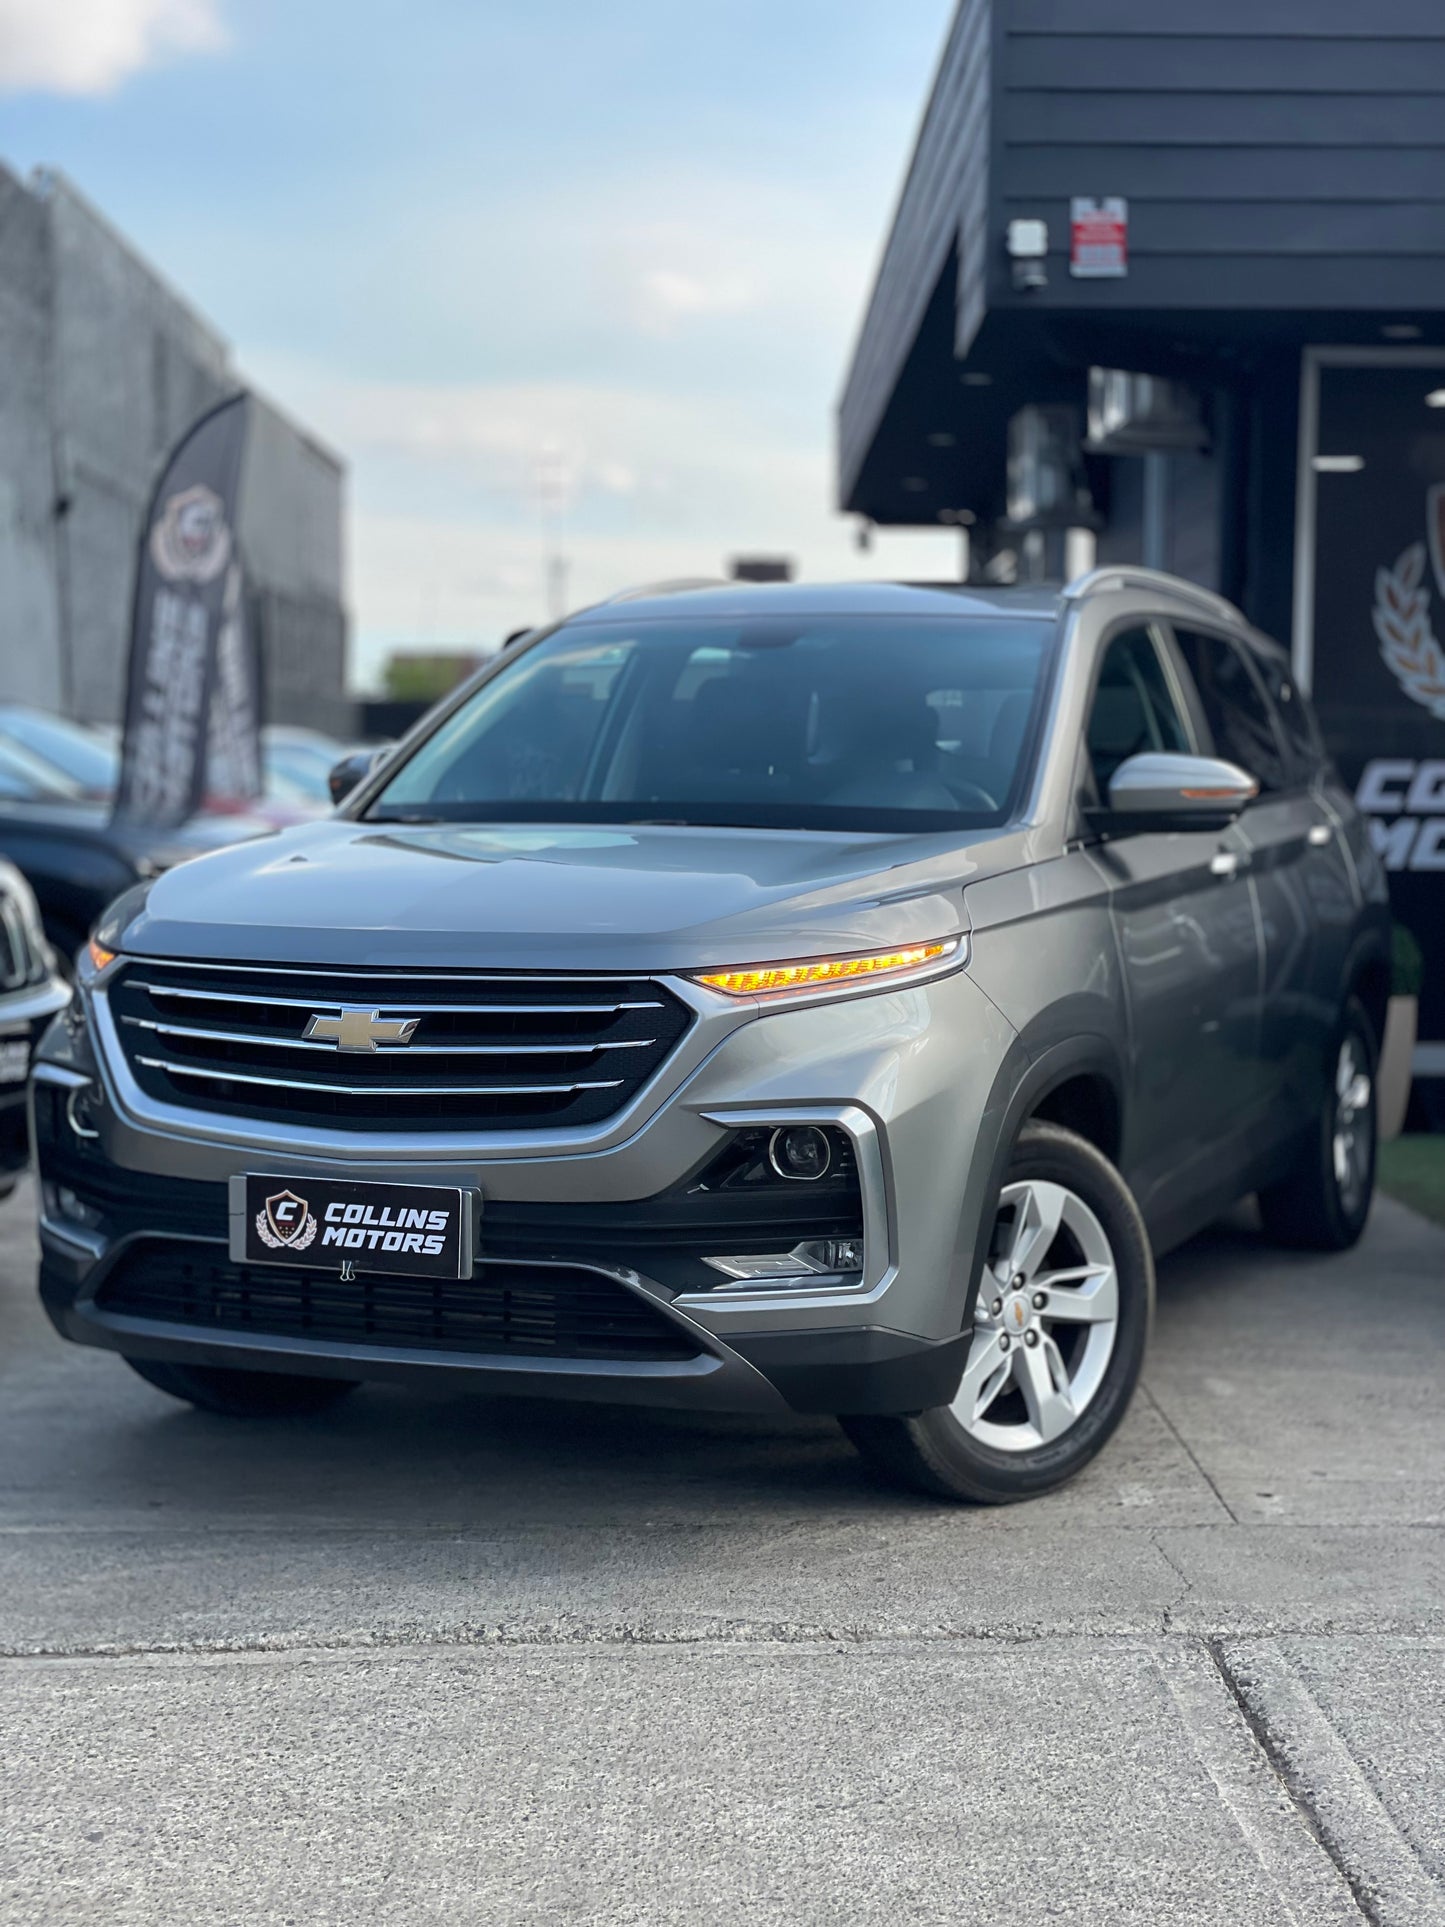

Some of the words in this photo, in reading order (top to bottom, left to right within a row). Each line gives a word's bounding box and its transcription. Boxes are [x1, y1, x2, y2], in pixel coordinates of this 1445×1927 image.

[276, 1202, 298, 1221] C
[325, 1203, 449, 1229] COLLINS
[322, 1227, 446, 1254] MOTORS
